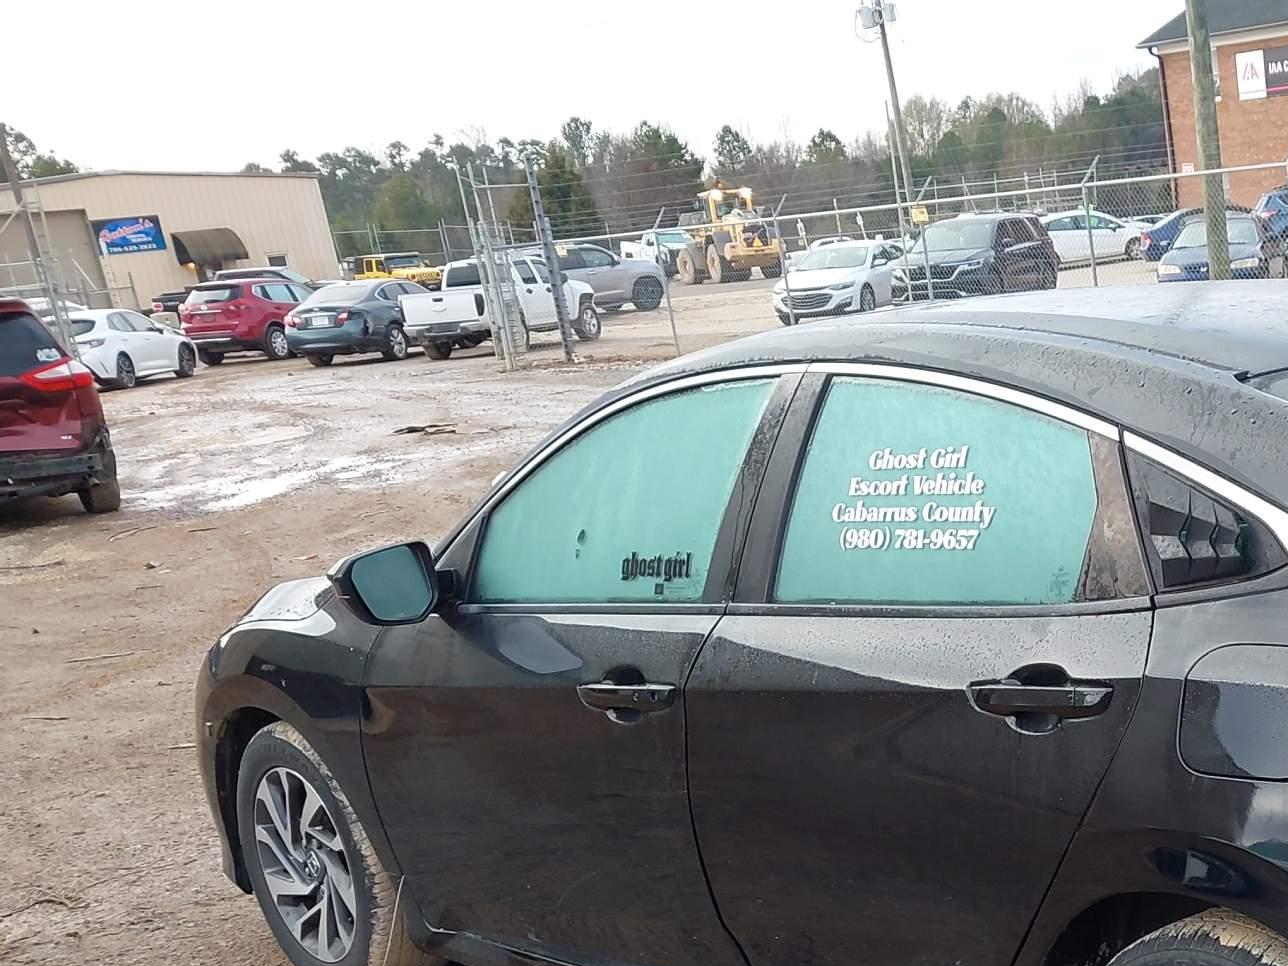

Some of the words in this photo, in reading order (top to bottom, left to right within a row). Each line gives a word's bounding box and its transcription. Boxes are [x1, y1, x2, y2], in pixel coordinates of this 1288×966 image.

[1268, 61, 1283, 74] IAA
[868, 447, 927, 470] Ghost
[930, 445, 969, 469] Girl
[848, 475, 908, 496] Escort
[913, 471, 985, 495] Vehicle
[831, 500, 918, 522] Cabarrus
[922, 500, 996, 529] County
[839, 526, 892, 551] (980)
[894, 528, 980, 551] 781-9657
